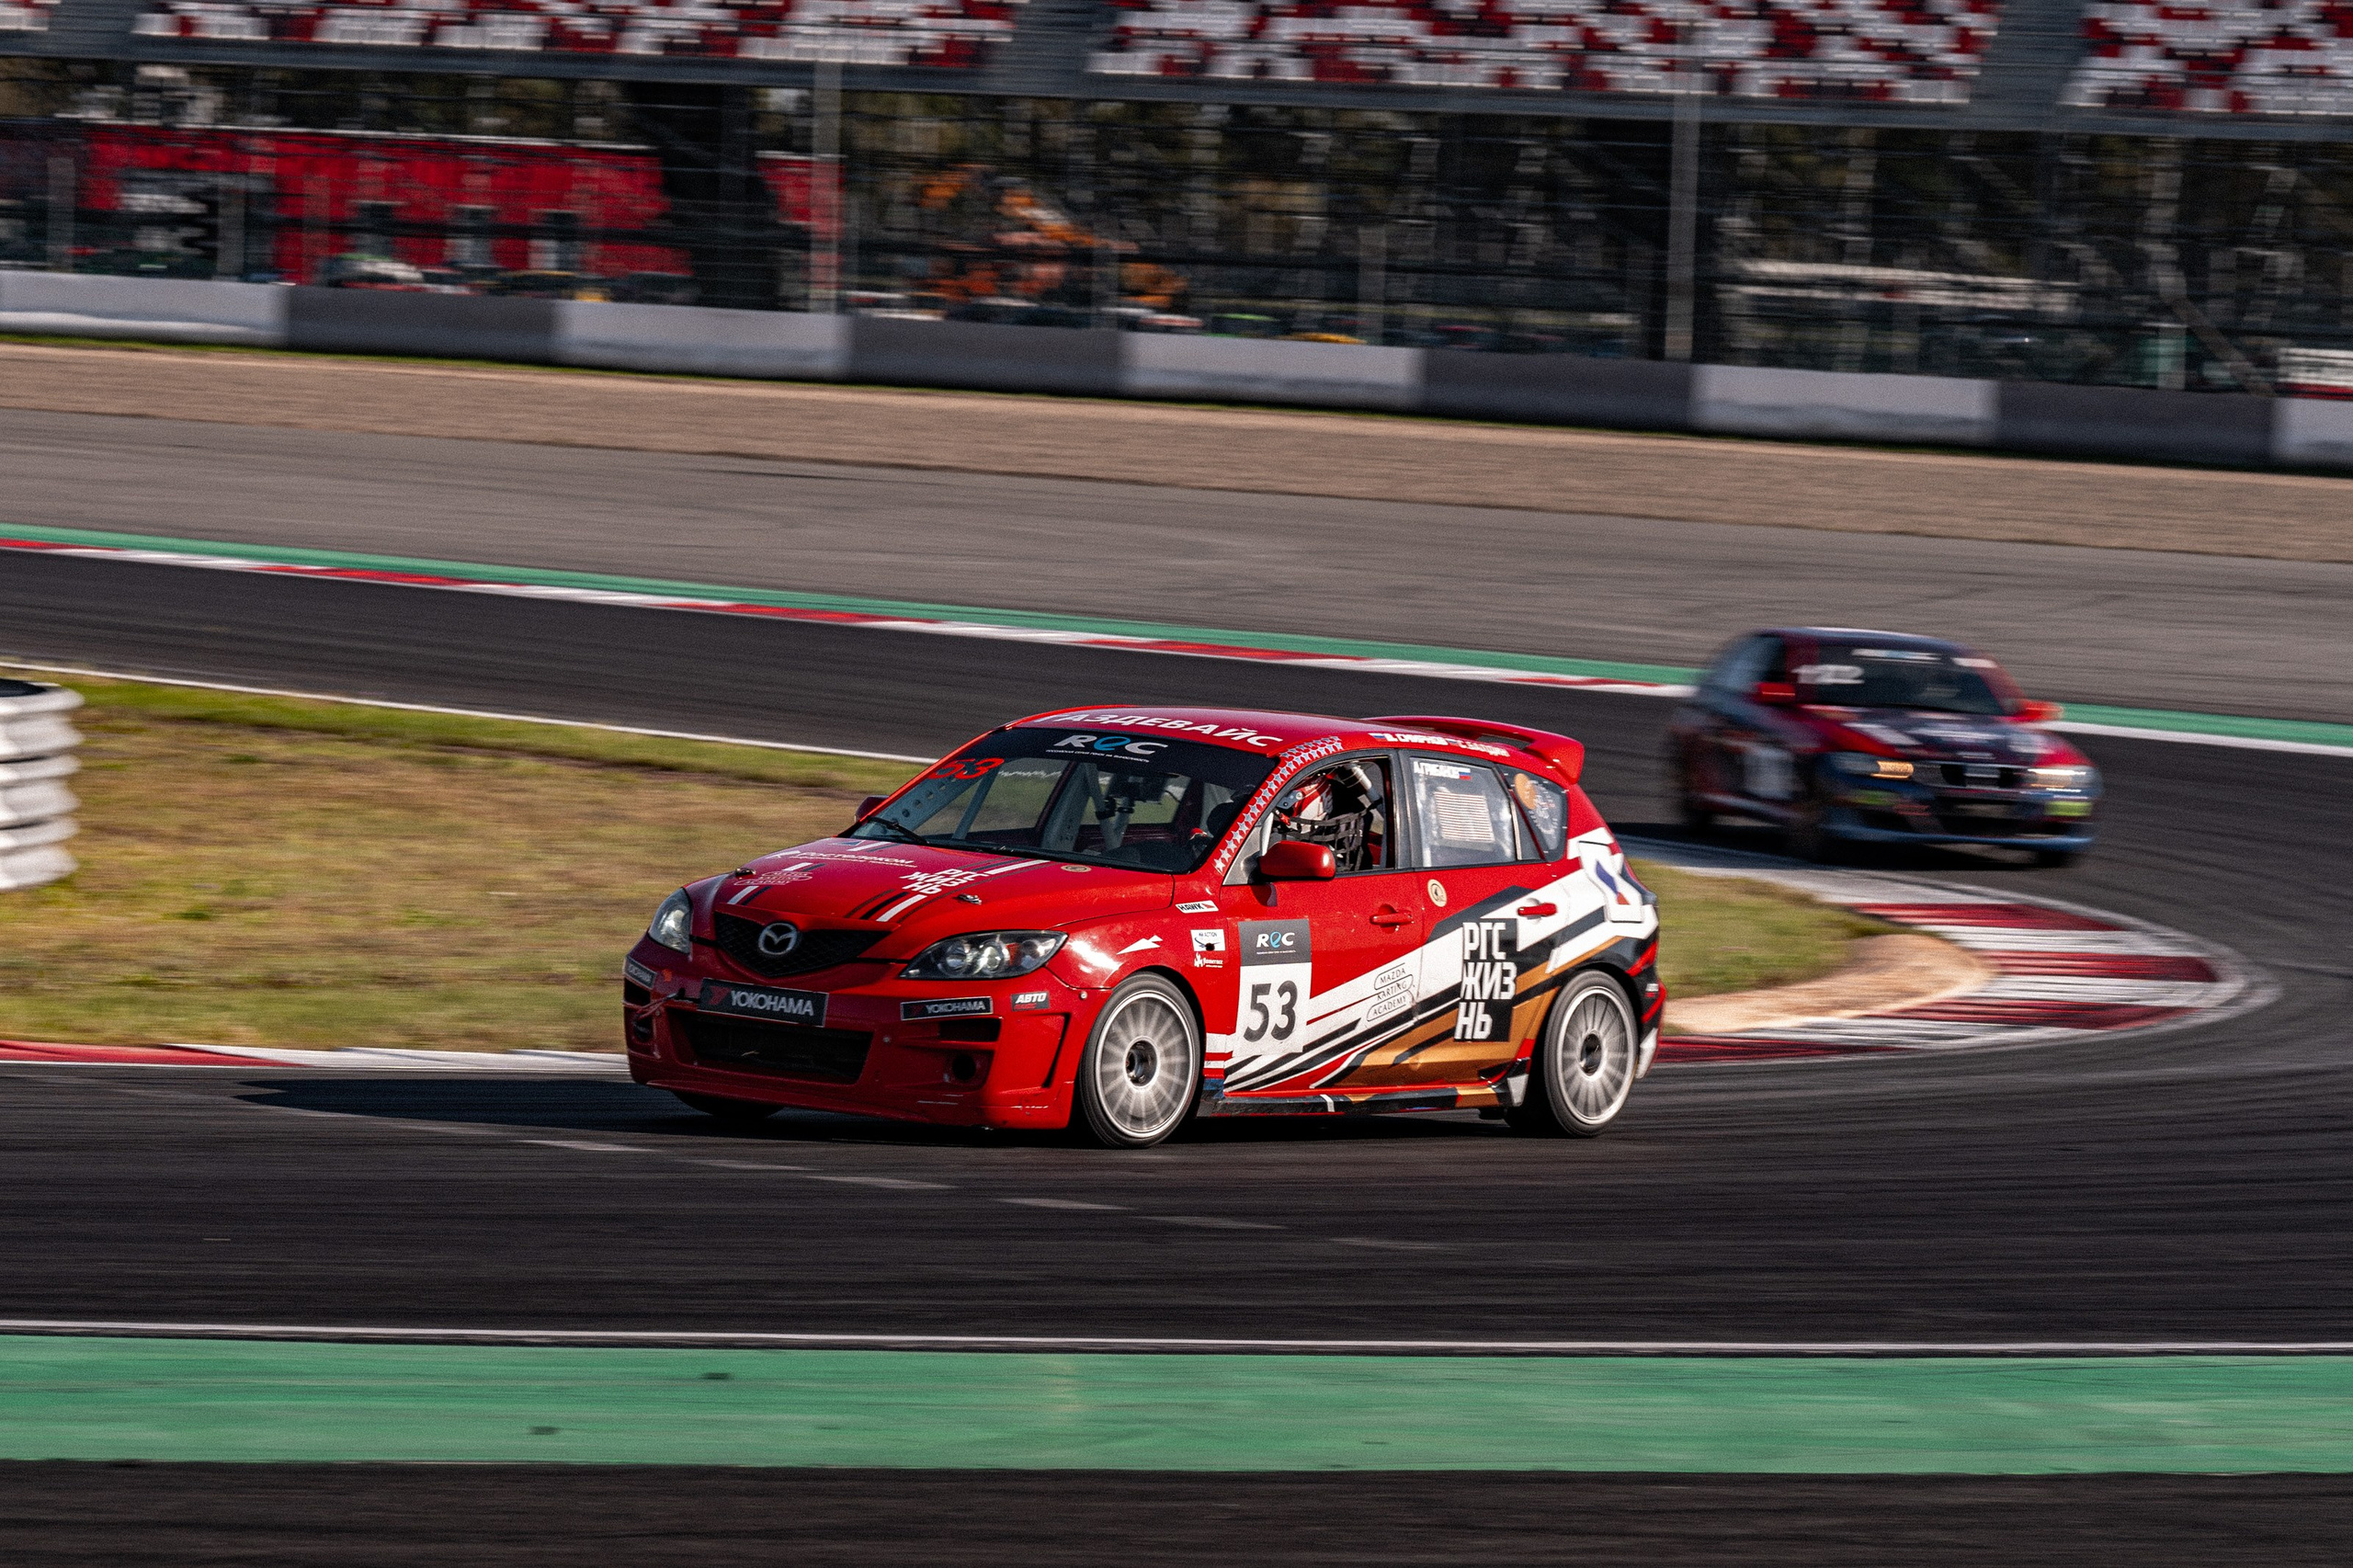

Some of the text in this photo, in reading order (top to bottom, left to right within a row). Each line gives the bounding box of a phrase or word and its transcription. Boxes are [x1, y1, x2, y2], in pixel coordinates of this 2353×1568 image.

[927, 757, 1005, 779] 53
[1178, 903, 1204, 911] HAWK
[1462, 922, 1506, 960] РГС
[1380, 968, 1405, 983] MAZDA
[1461, 961, 1517, 1000] ЖИЗ
[1377, 981, 1407, 1001] KARTING
[731, 990, 814, 1017] YOKOHAMA
[926, 1000, 986, 1014] YOKOHAMA
[1243, 980, 1298, 1042] 53
[1373, 995, 1406, 1016] ACADEMY
[1454, 1002, 1493, 1040] НЬ
